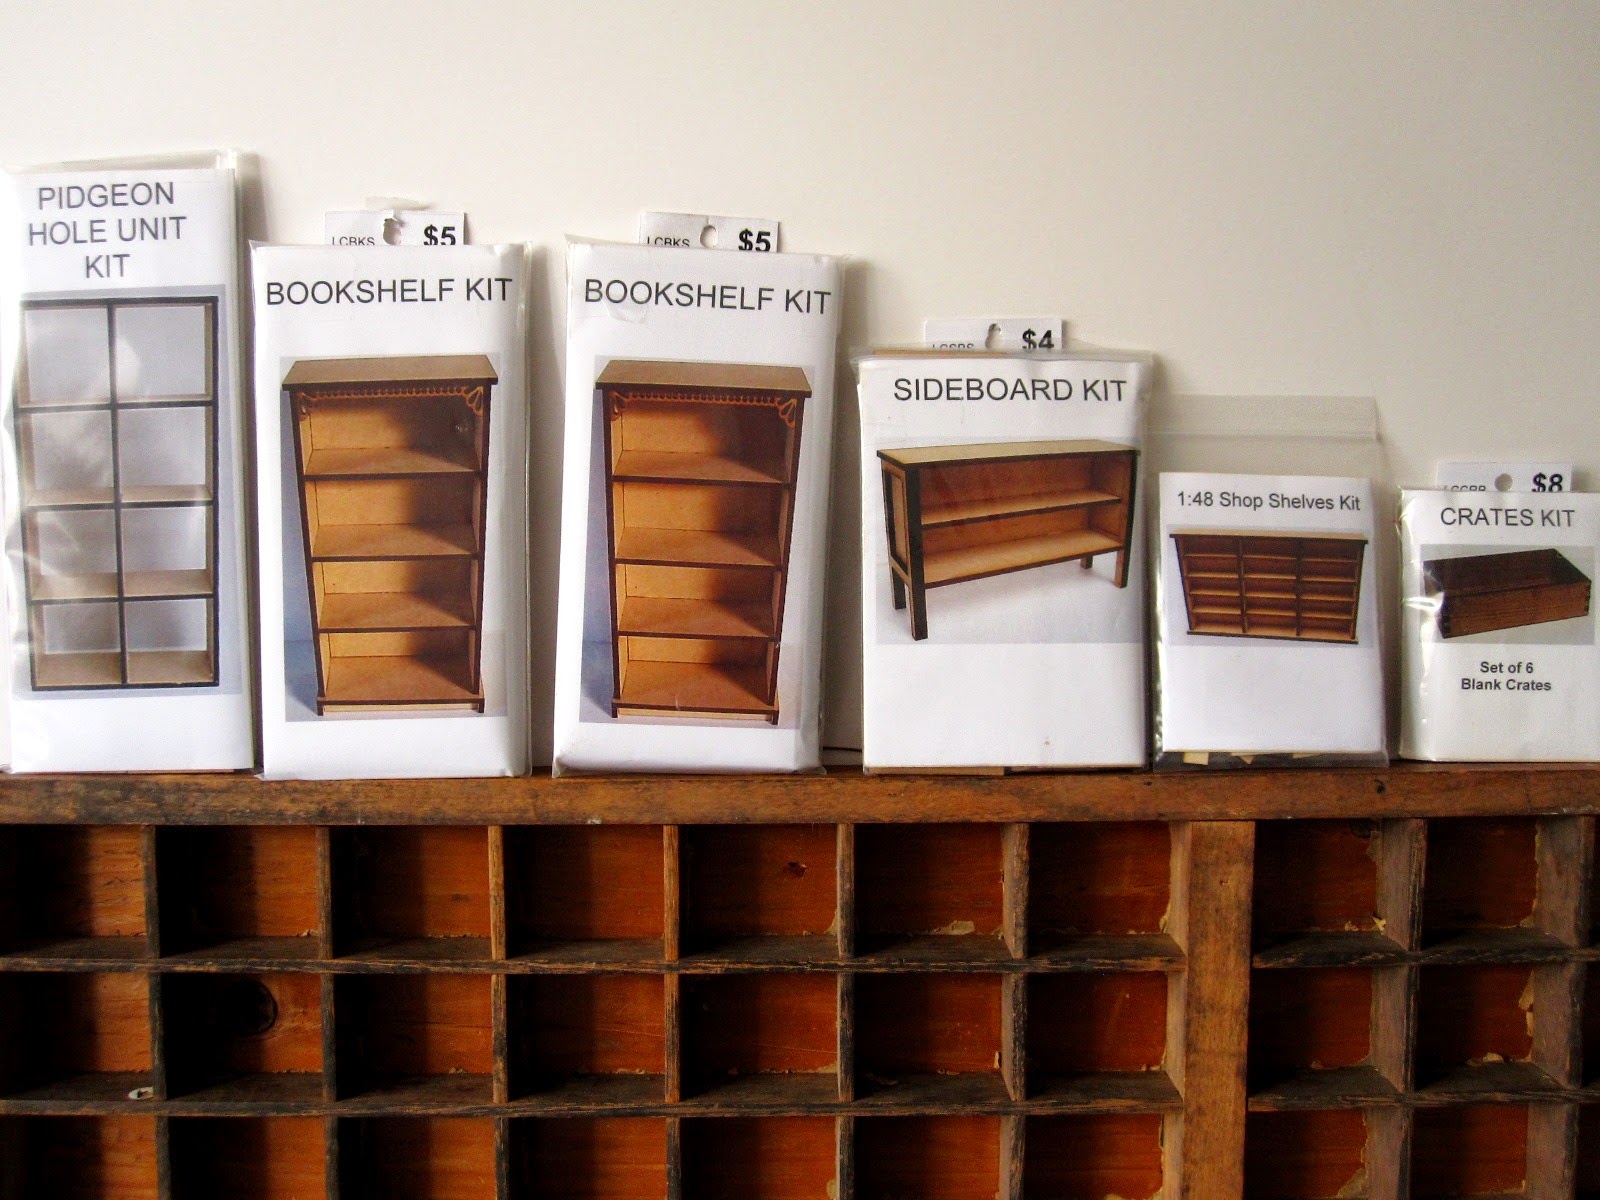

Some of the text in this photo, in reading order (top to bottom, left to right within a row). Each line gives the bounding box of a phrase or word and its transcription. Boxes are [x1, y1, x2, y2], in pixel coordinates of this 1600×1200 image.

[38, 181, 174, 210] PIDGEON
[29, 216, 187, 246] HOLE UNIT
[423, 224, 456, 246] $5
[738, 228, 771, 252] $5
[85, 254, 130, 278] KIT
[266, 278, 513, 305] BOOKSHELF KIT
[585, 278, 832, 314] BOOKSHELF KIT
[1022, 328, 1054, 350] $4
[893, 377, 1127, 402] SIDEBOARD KIT
[1532, 472, 1563, 493] $8
[1177, 491, 1361, 511] 1:48 Shop Shelves Kit
[1440, 507, 1575, 527] CRATES KIT
[1480, 661, 1534, 674] Set of 6
[1461, 678, 1552, 691] Blank Crates
